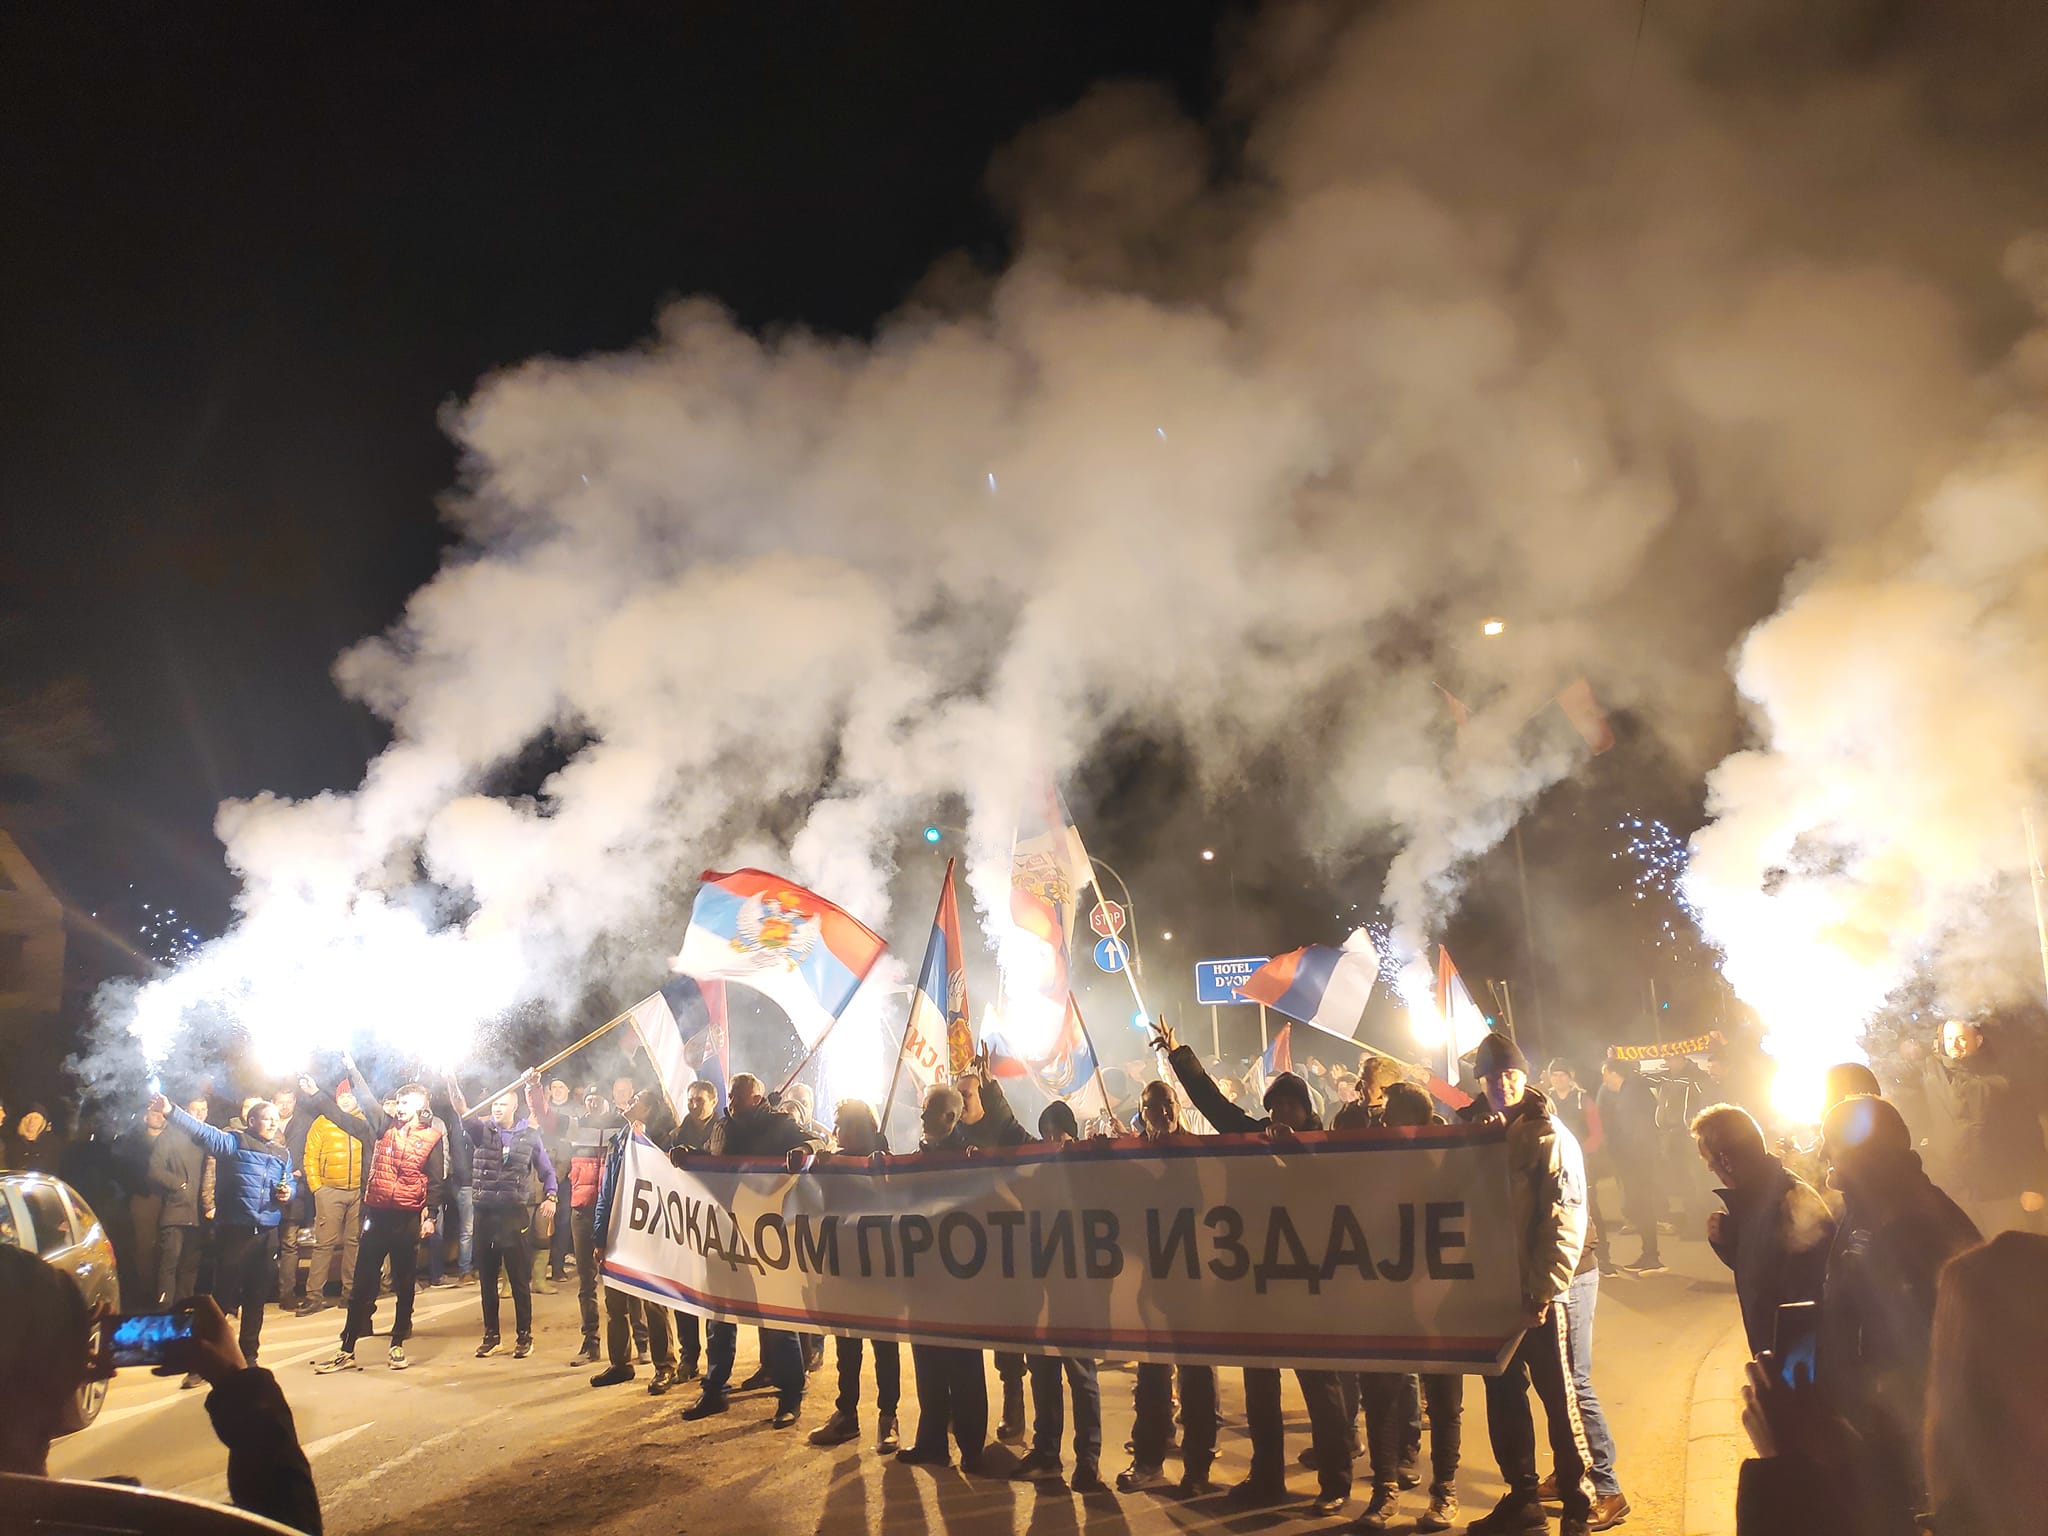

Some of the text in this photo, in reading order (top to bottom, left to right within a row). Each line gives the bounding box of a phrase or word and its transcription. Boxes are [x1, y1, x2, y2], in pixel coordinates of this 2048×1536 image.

[1213, 963, 1252, 974] HOTEL
[628, 1177, 1475, 1295] БЛОКАДОМ ПРОТИВ ИЗДАЈЕ
